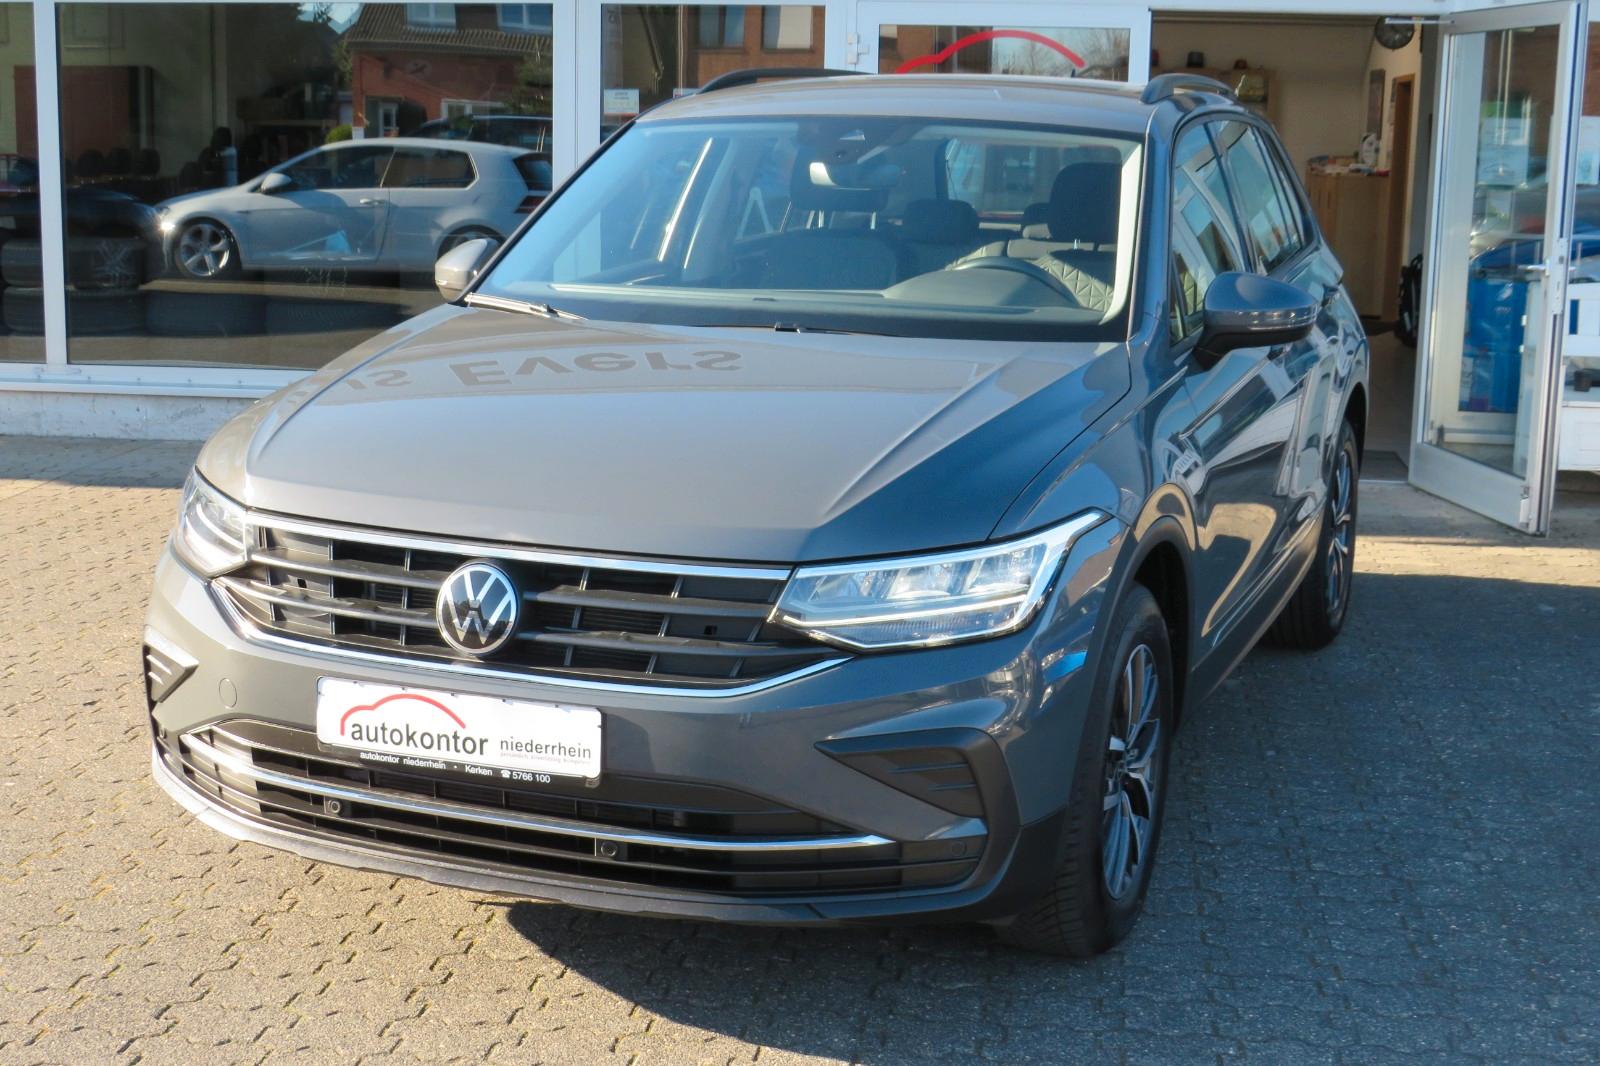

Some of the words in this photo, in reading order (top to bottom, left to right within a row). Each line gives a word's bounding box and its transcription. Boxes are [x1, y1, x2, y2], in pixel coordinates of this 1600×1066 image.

[351, 721, 488, 756] autokontor
[500, 736, 591, 759] niederrhein
[360, 750, 400, 764] autokontor
[403, 756, 447, 770] niederrhein
[464, 764, 493, 776] Kerken
[535, 773, 551, 784] 100
